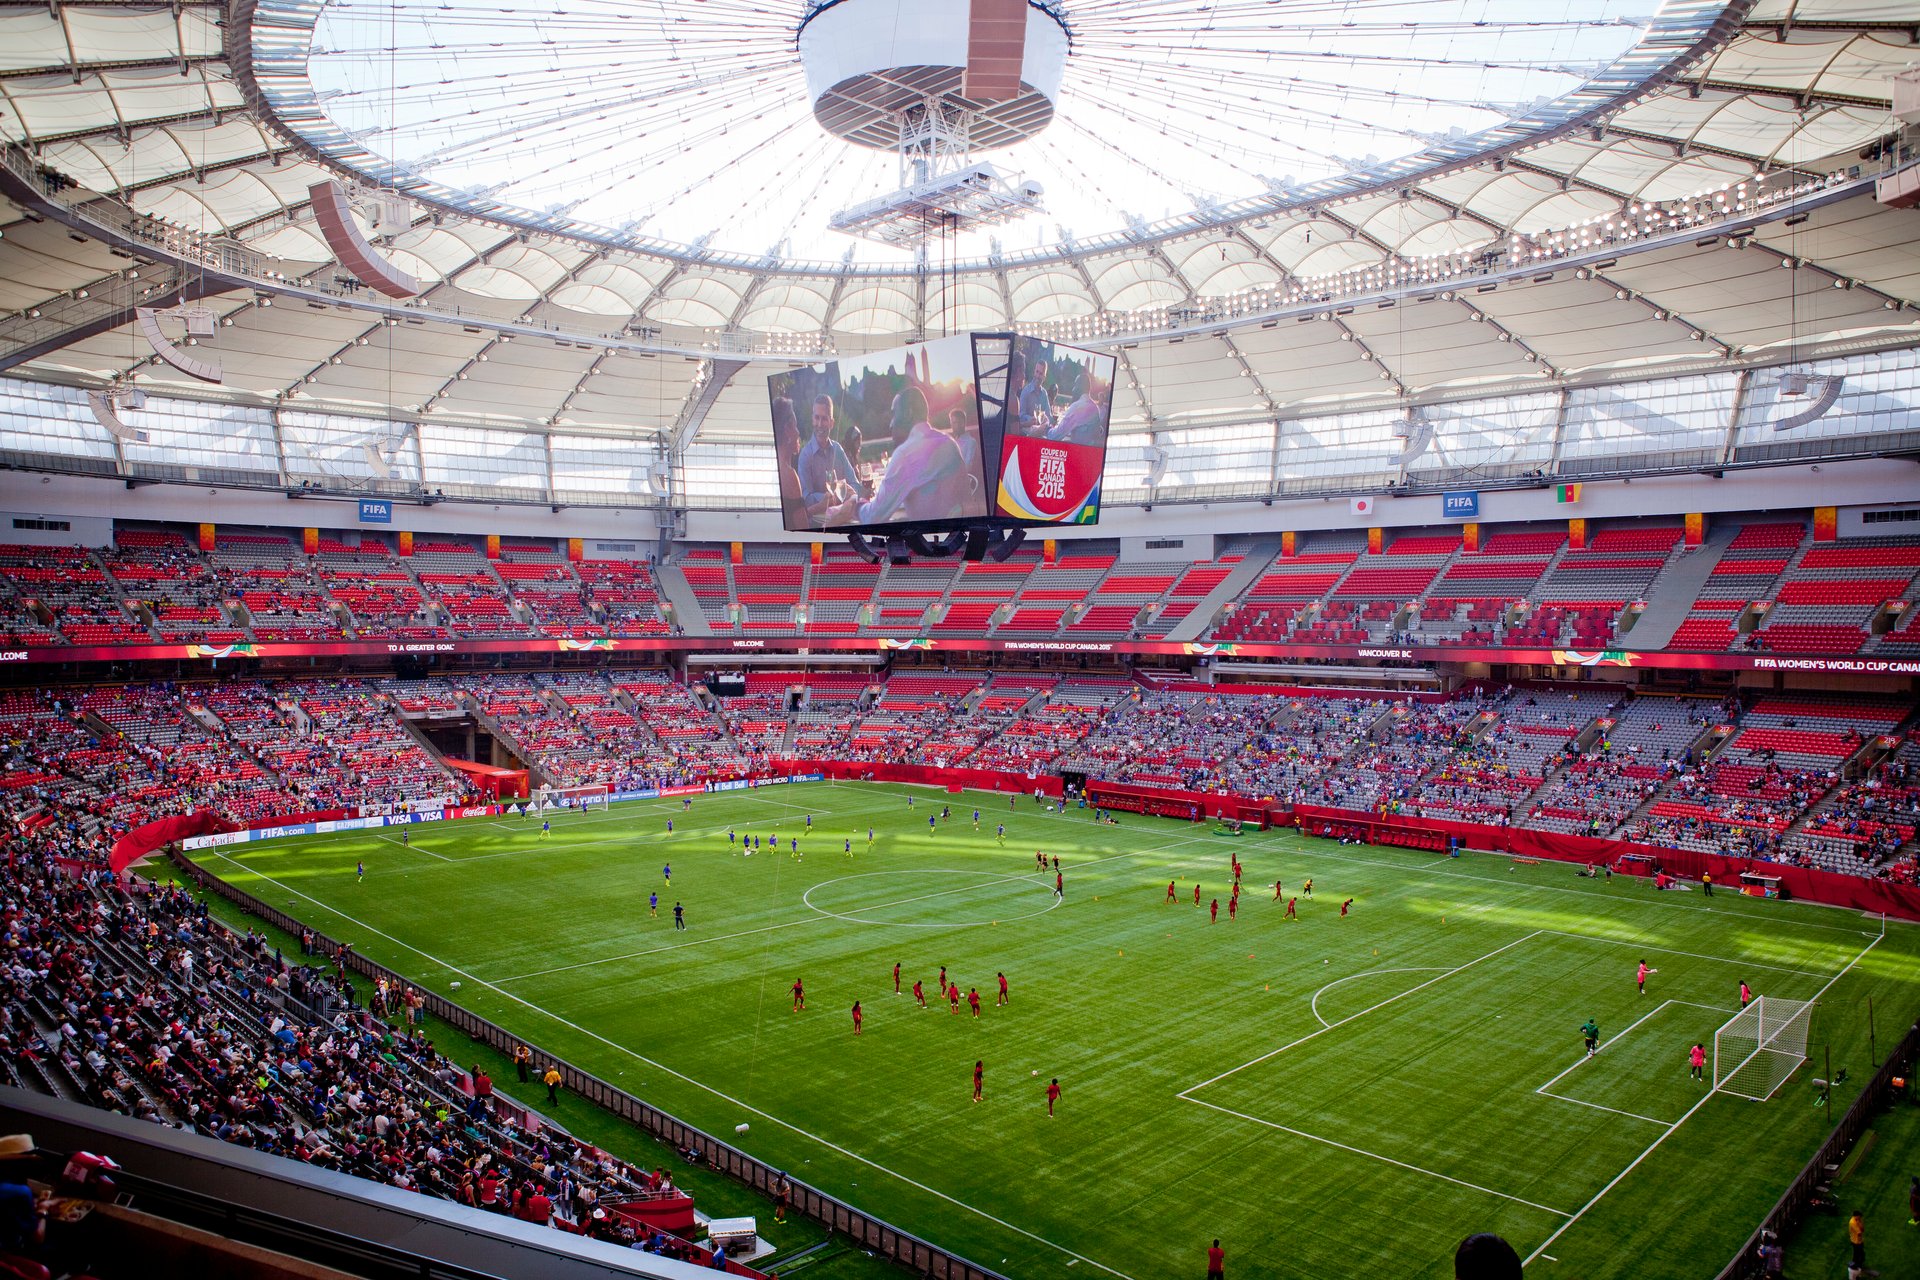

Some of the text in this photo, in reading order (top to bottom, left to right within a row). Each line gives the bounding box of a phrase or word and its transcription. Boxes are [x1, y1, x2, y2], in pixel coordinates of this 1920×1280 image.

[1040, 448, 1059, 456] COUPE
[1039, 458, 1066, 475] FIFA
[1038, 472, 1065, 484] CANADA
[1036, 480, 1065, 500] 2015
[1448, 498, 1473, 508] FIFA
[363, 504, 387, 514] FIFA
[1358, 650, 1400, 658] VANCOUVER
[1754, 659, 1920, 672] FIFA WOMEN'S WORLD CUP CANA
[418, 811, 442, 821] VISA
[462, 807, 487, 817] Coca-Cola
[387, 814, 412, 825] VISA
[198, 834, 235, 847] Canada
